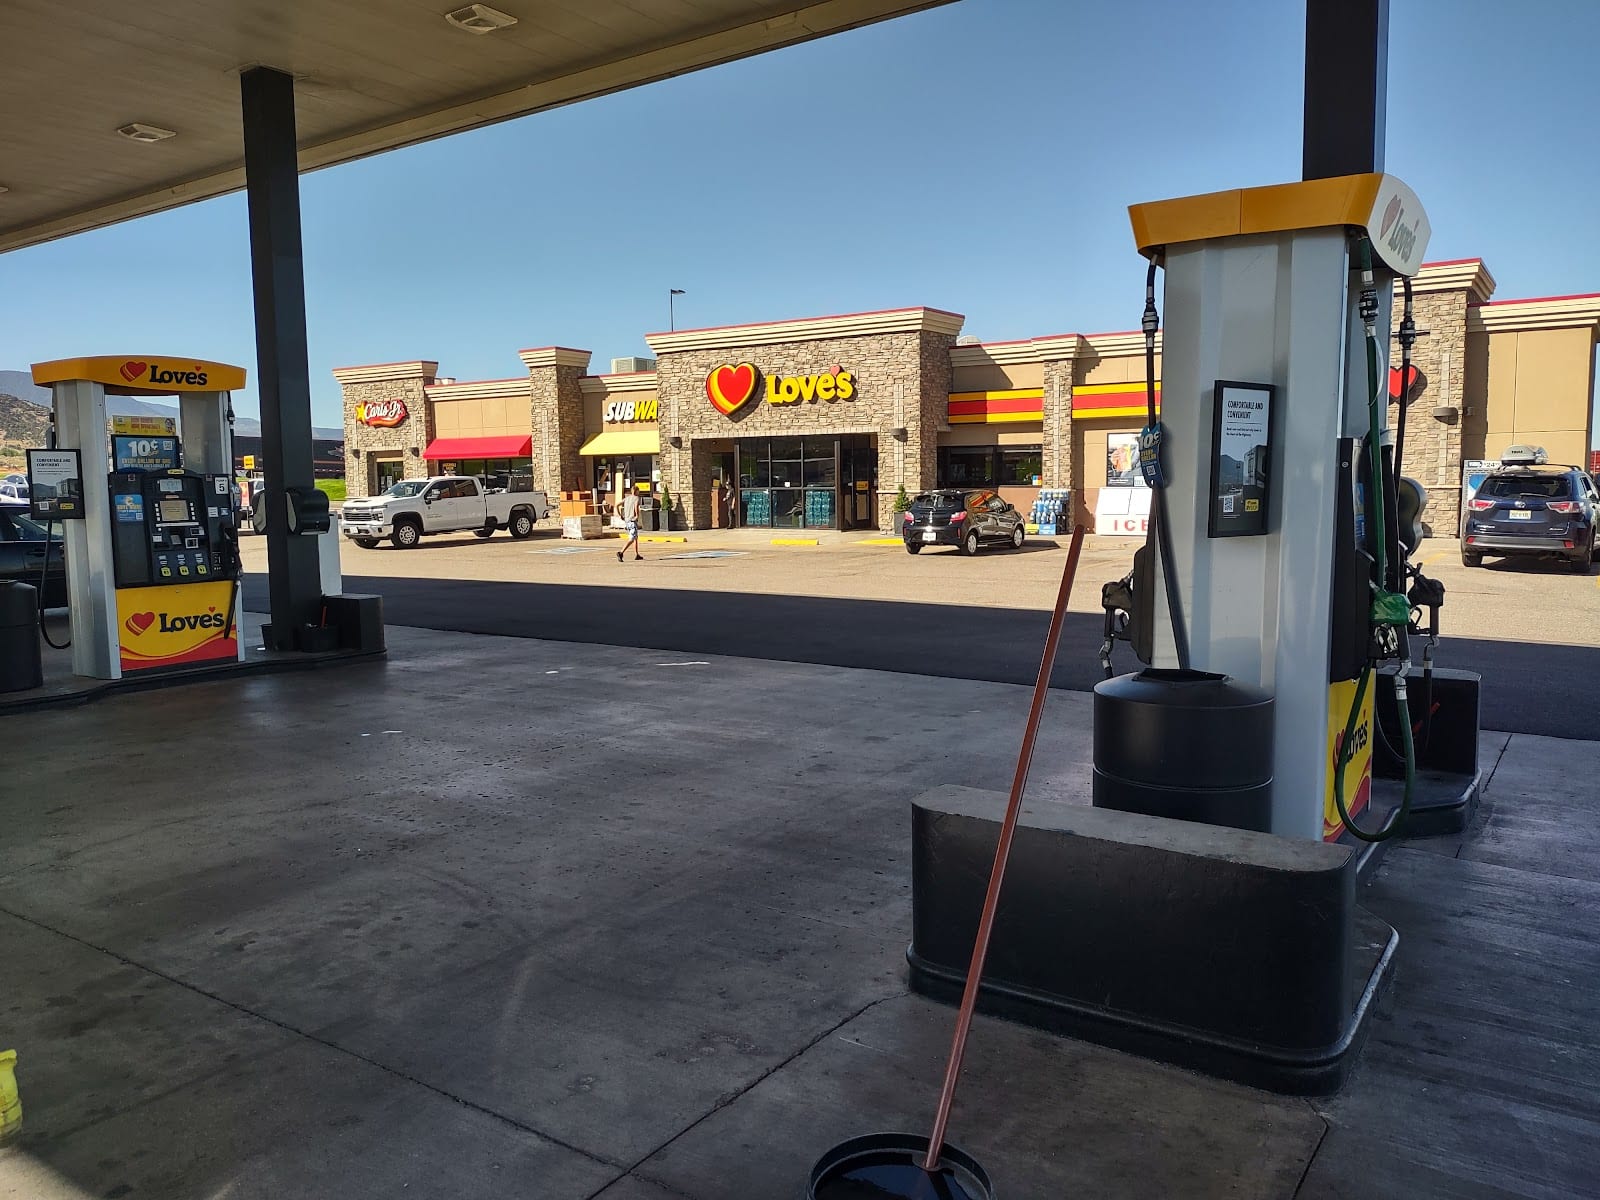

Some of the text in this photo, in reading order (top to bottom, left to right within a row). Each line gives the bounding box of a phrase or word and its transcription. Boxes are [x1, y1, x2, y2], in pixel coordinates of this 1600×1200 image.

[766, 365, 853, 404] Love's
[603, 400, 658, 421] SUBWA
[1255, 402, 1264, 410] AND
[218, 483, 225, 492] 5
[1114, 519, 1148, 531] ICE
[159, 607, 224, 632] Love's
